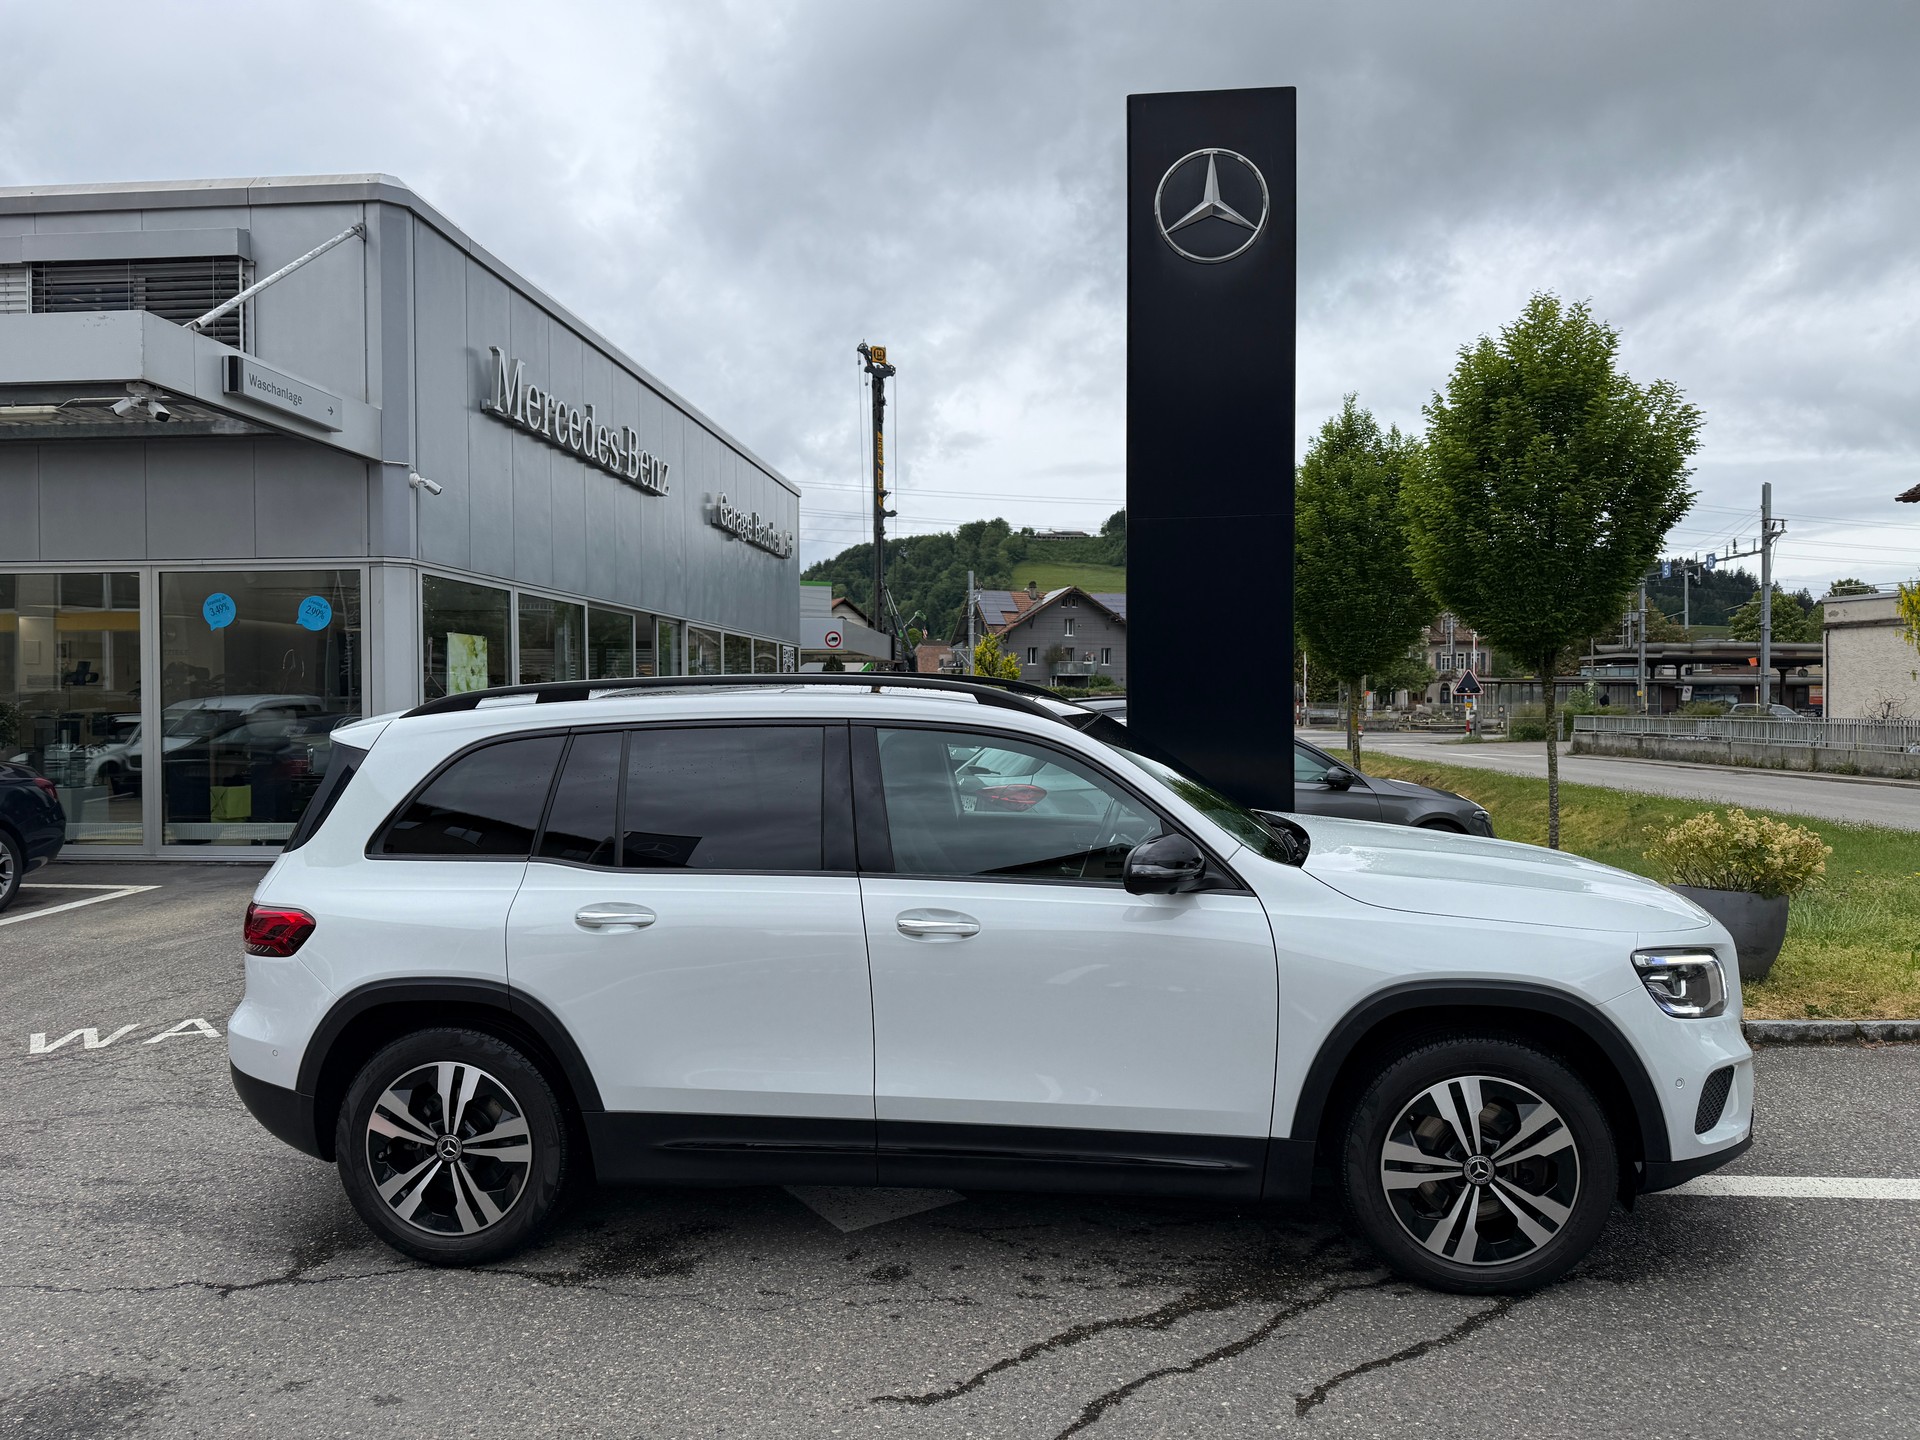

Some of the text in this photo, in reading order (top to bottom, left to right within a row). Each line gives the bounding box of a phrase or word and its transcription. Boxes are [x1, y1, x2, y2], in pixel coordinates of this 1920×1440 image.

[248, 372, 303, 406] Waschanlage
[487, 346, 671, 497] Mercedes-Benz
[719, 492, 752, 541] Garage
[209, 602, 230, 617] 3.49%
